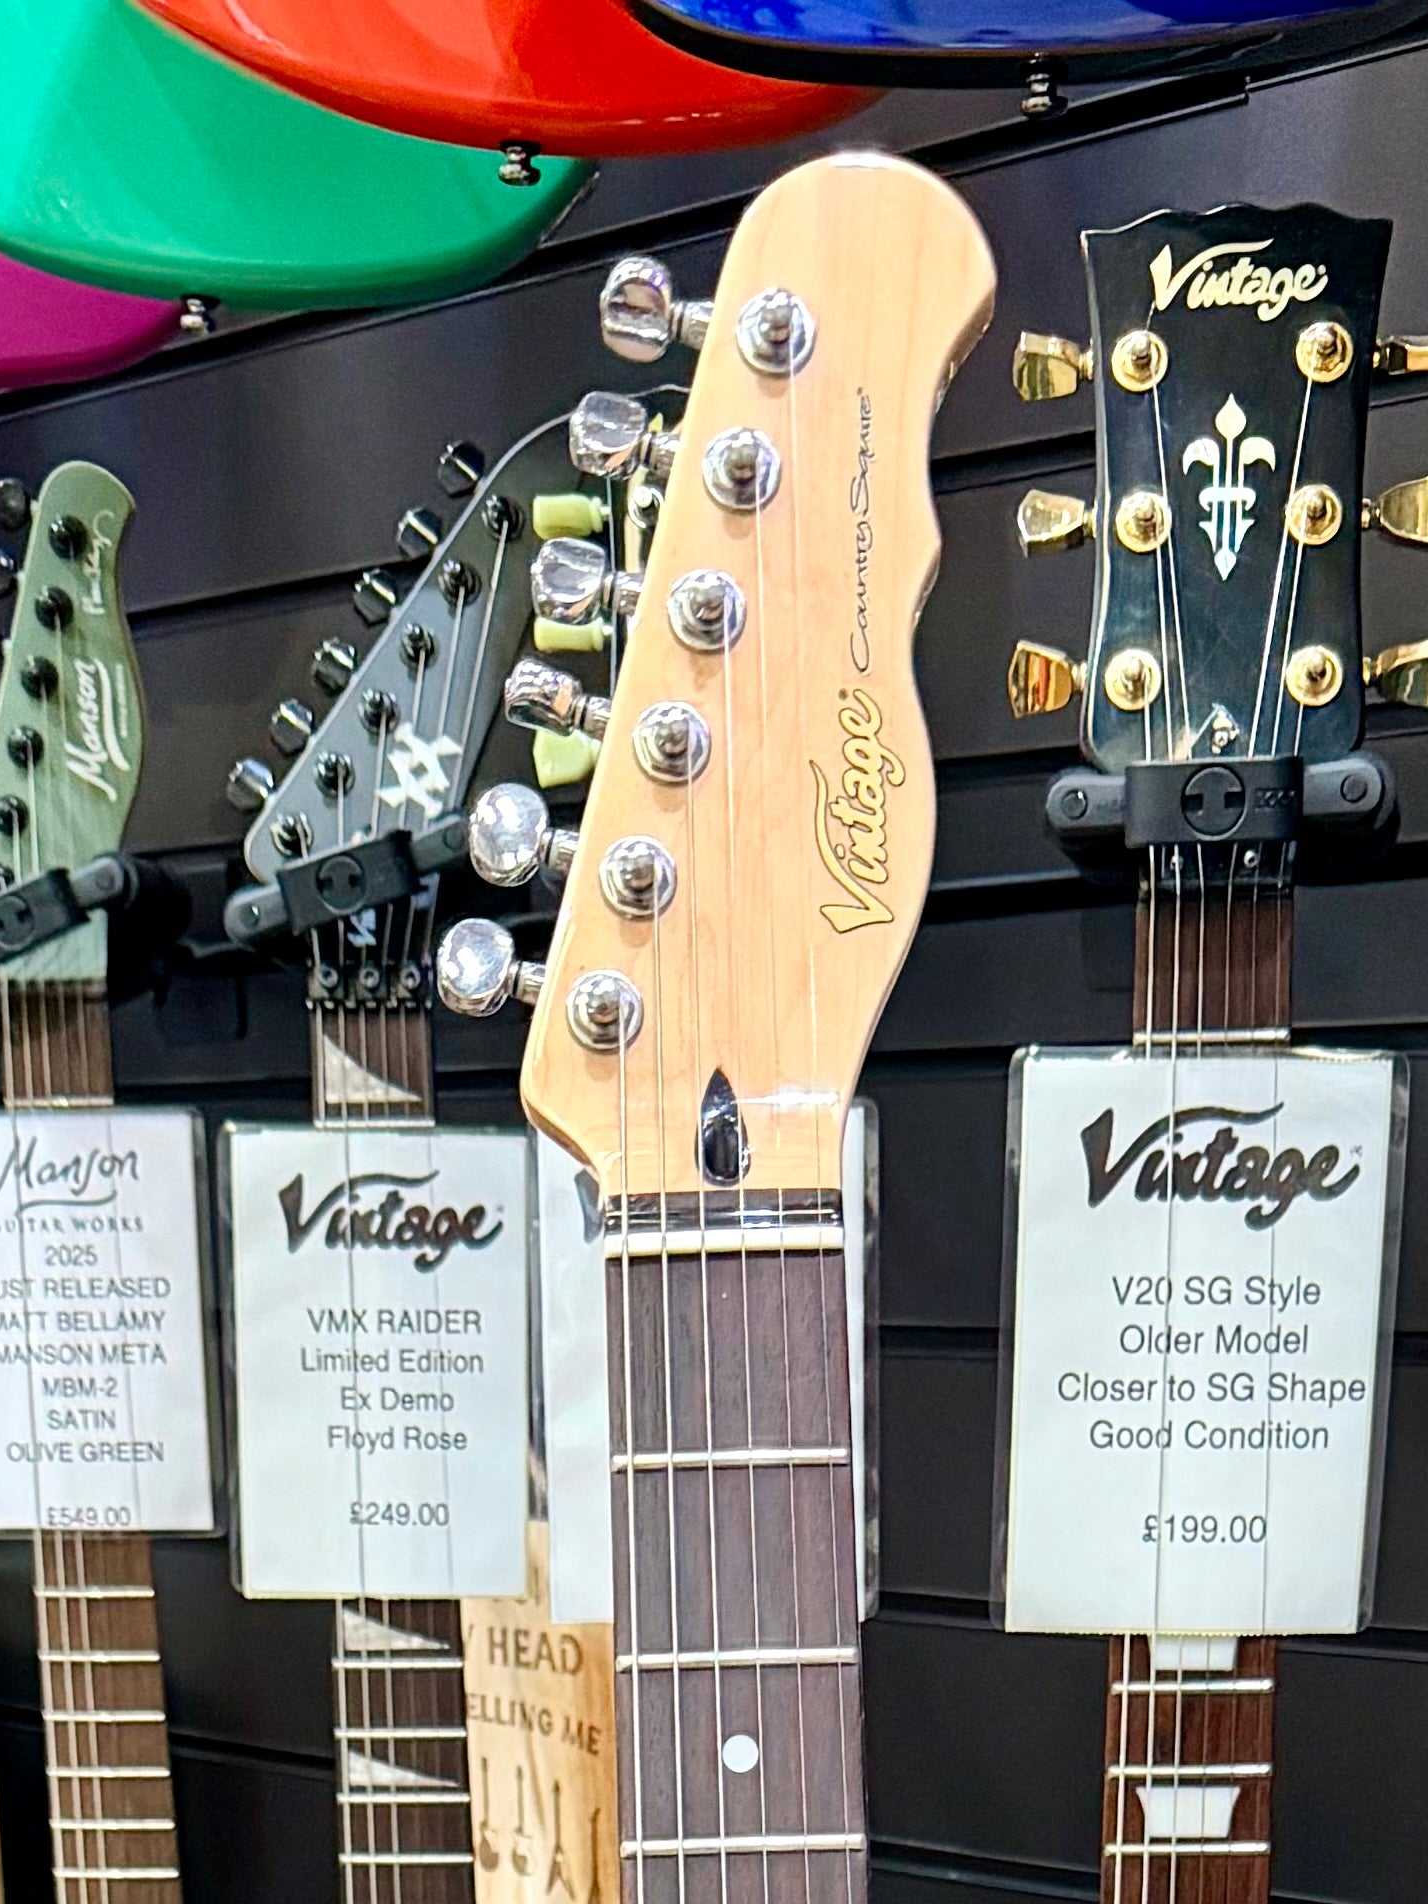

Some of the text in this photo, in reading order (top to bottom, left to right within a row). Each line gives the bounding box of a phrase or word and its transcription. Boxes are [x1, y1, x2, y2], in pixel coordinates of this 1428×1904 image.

[1150, 237, 1329, 321] Vintage
[64, 658, 118, 802] Manson
[809, 687, 906, 934] Vintage
[1079, 1102, 1361, 1231] Vintage
[73, 1217, 143, 1233] WORKS
[278, 1170, 504, 1274] Vintage
[45, 1245, 98, 1267] 2025
[44, 1277, 171, 1299] RELEASED
[1111, 1275, 1322, 1314] V20 SG Style
[57, 1310, 167, 1332] BELLAMY
[307, 1309, 482, 1334] VMX RAIDER
[101, 1343, 168, 1365] META
[1119, 1324, 1309, 1356] Older Model
[301, 1347, 484, 1374] Limited Edition
[42, 1377, 118, 1398] MBM-2
[341, 1387, 455, 1412] Ex Demo
[1057, 1372, 1367, 1411] Closer to SG Shape
[47, 1409, 116, 1430] SATIN
[328, 1425, 468, 1455] Floyd Rose
[1088, 1420, 1330, 1452] Good Condition
[6, 1441, 165, 1463] OLIVE GREEN
[47, 1506, 131, 1527] £549.00
[350, 1502, 450, 1527] £249.00
[1142, 1514, 1268, 1546] £199.00
[488, 1625, 584, 1677] HEAD
[468, 1693, 602, 1756] ELLING ME
